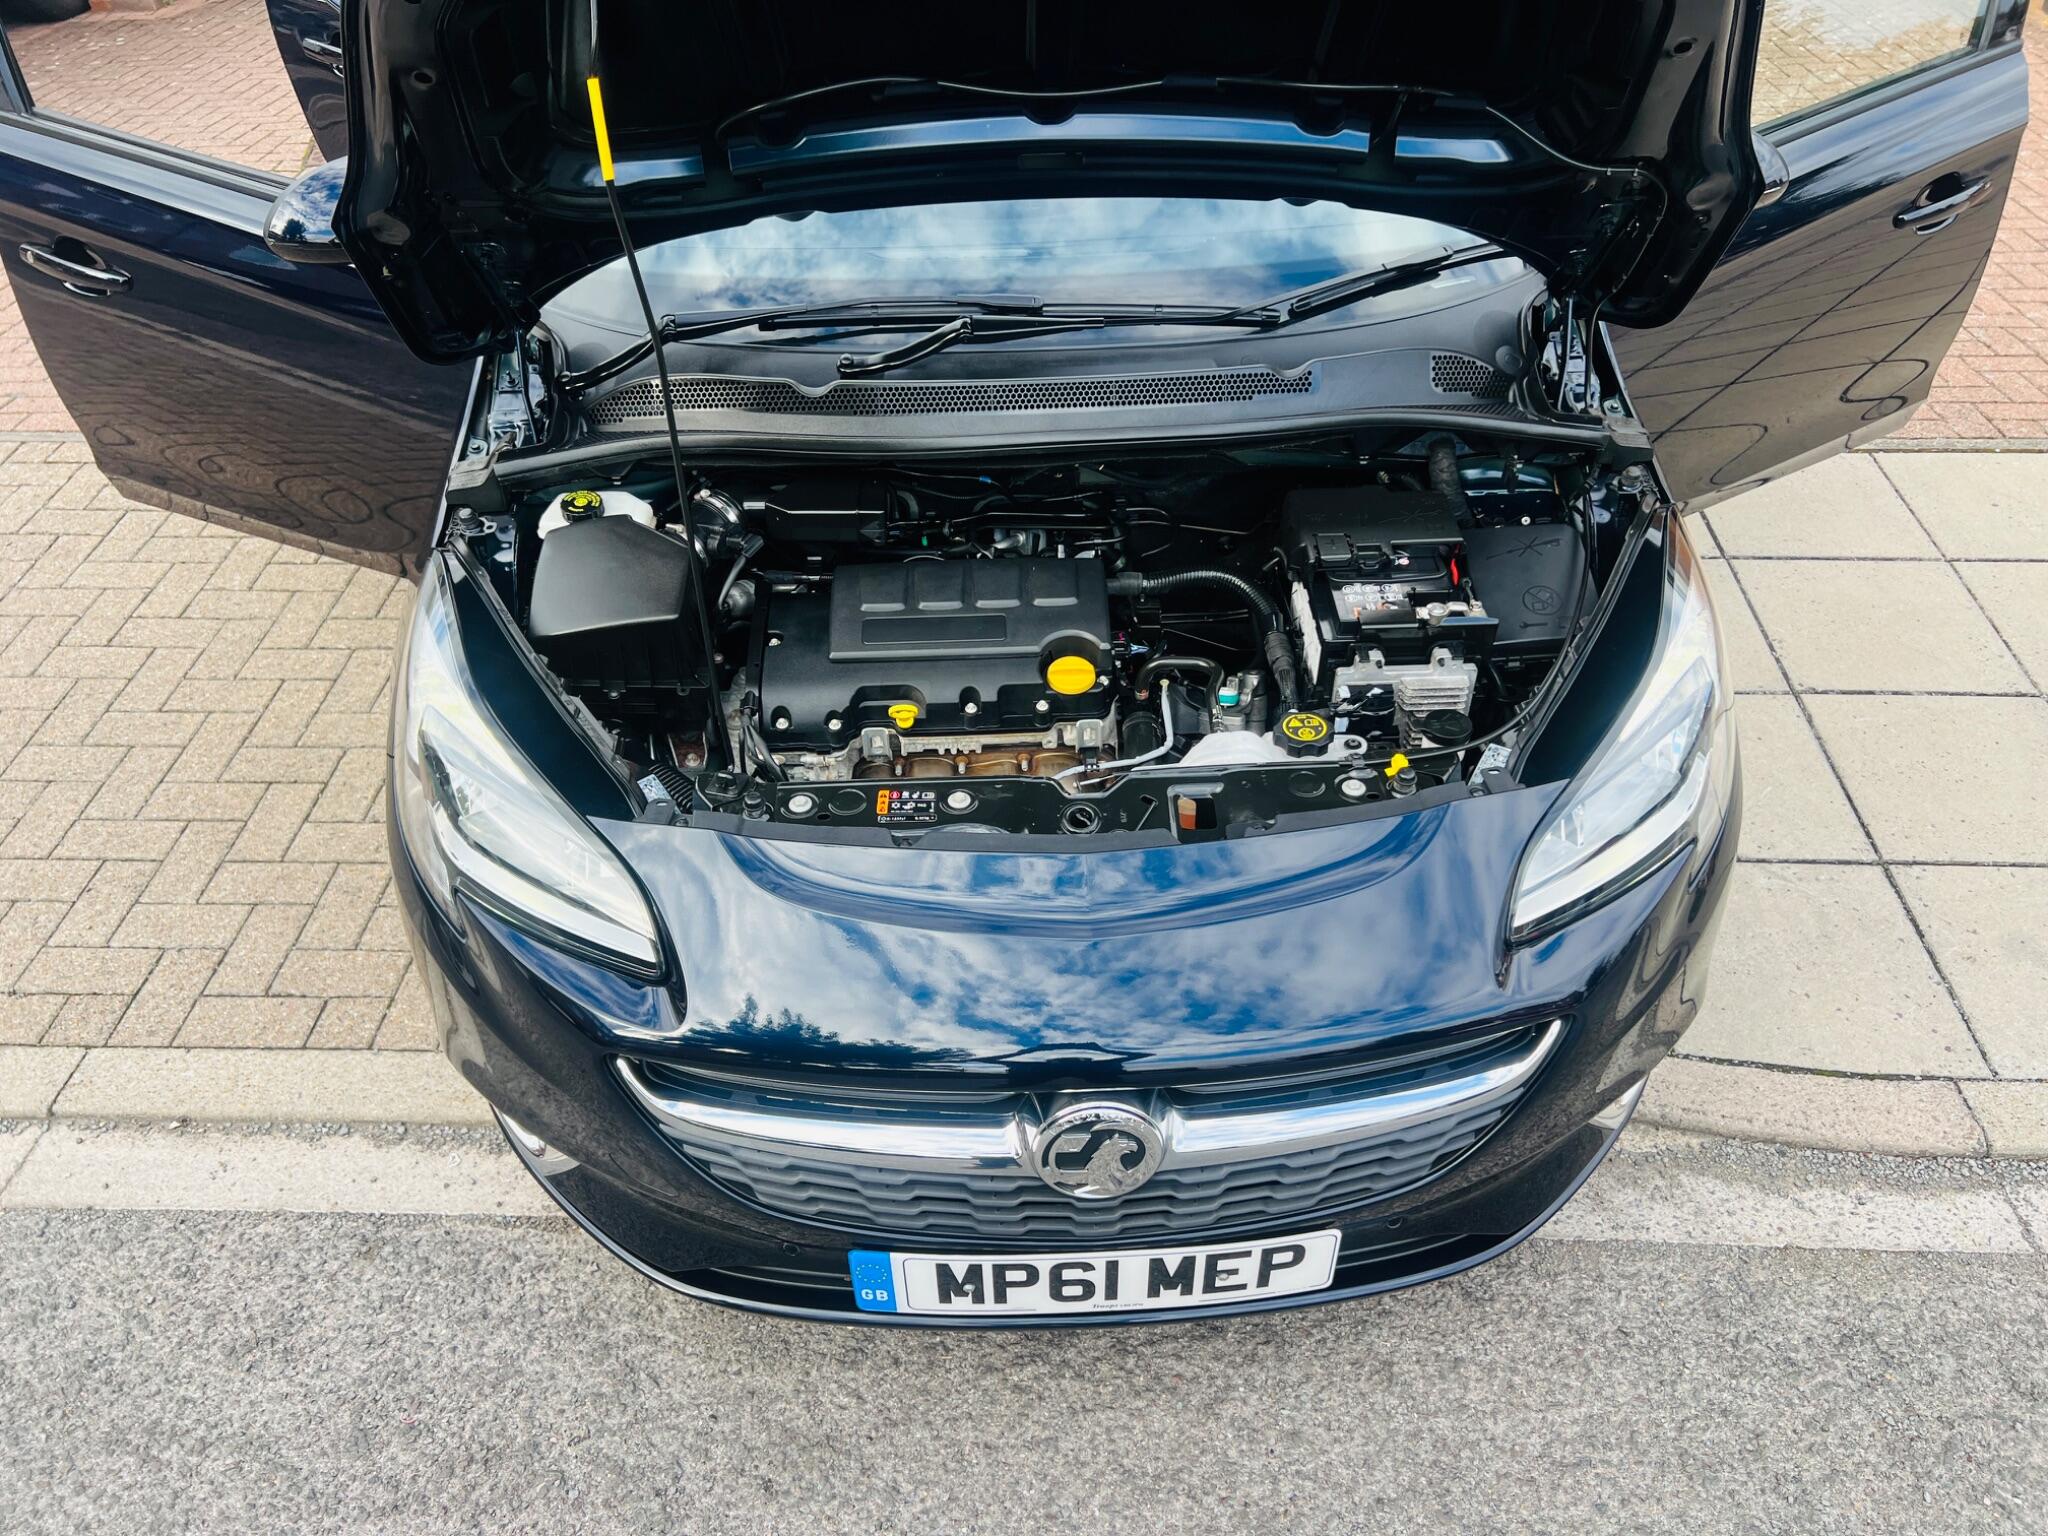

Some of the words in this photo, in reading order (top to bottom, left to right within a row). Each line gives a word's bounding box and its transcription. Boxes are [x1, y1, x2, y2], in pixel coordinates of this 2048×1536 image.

[935, 1260, 1119, 1304] MP61
[1146, 1244, 1306, 1299] MEP
[861, 1289, 889, 1301] GB
